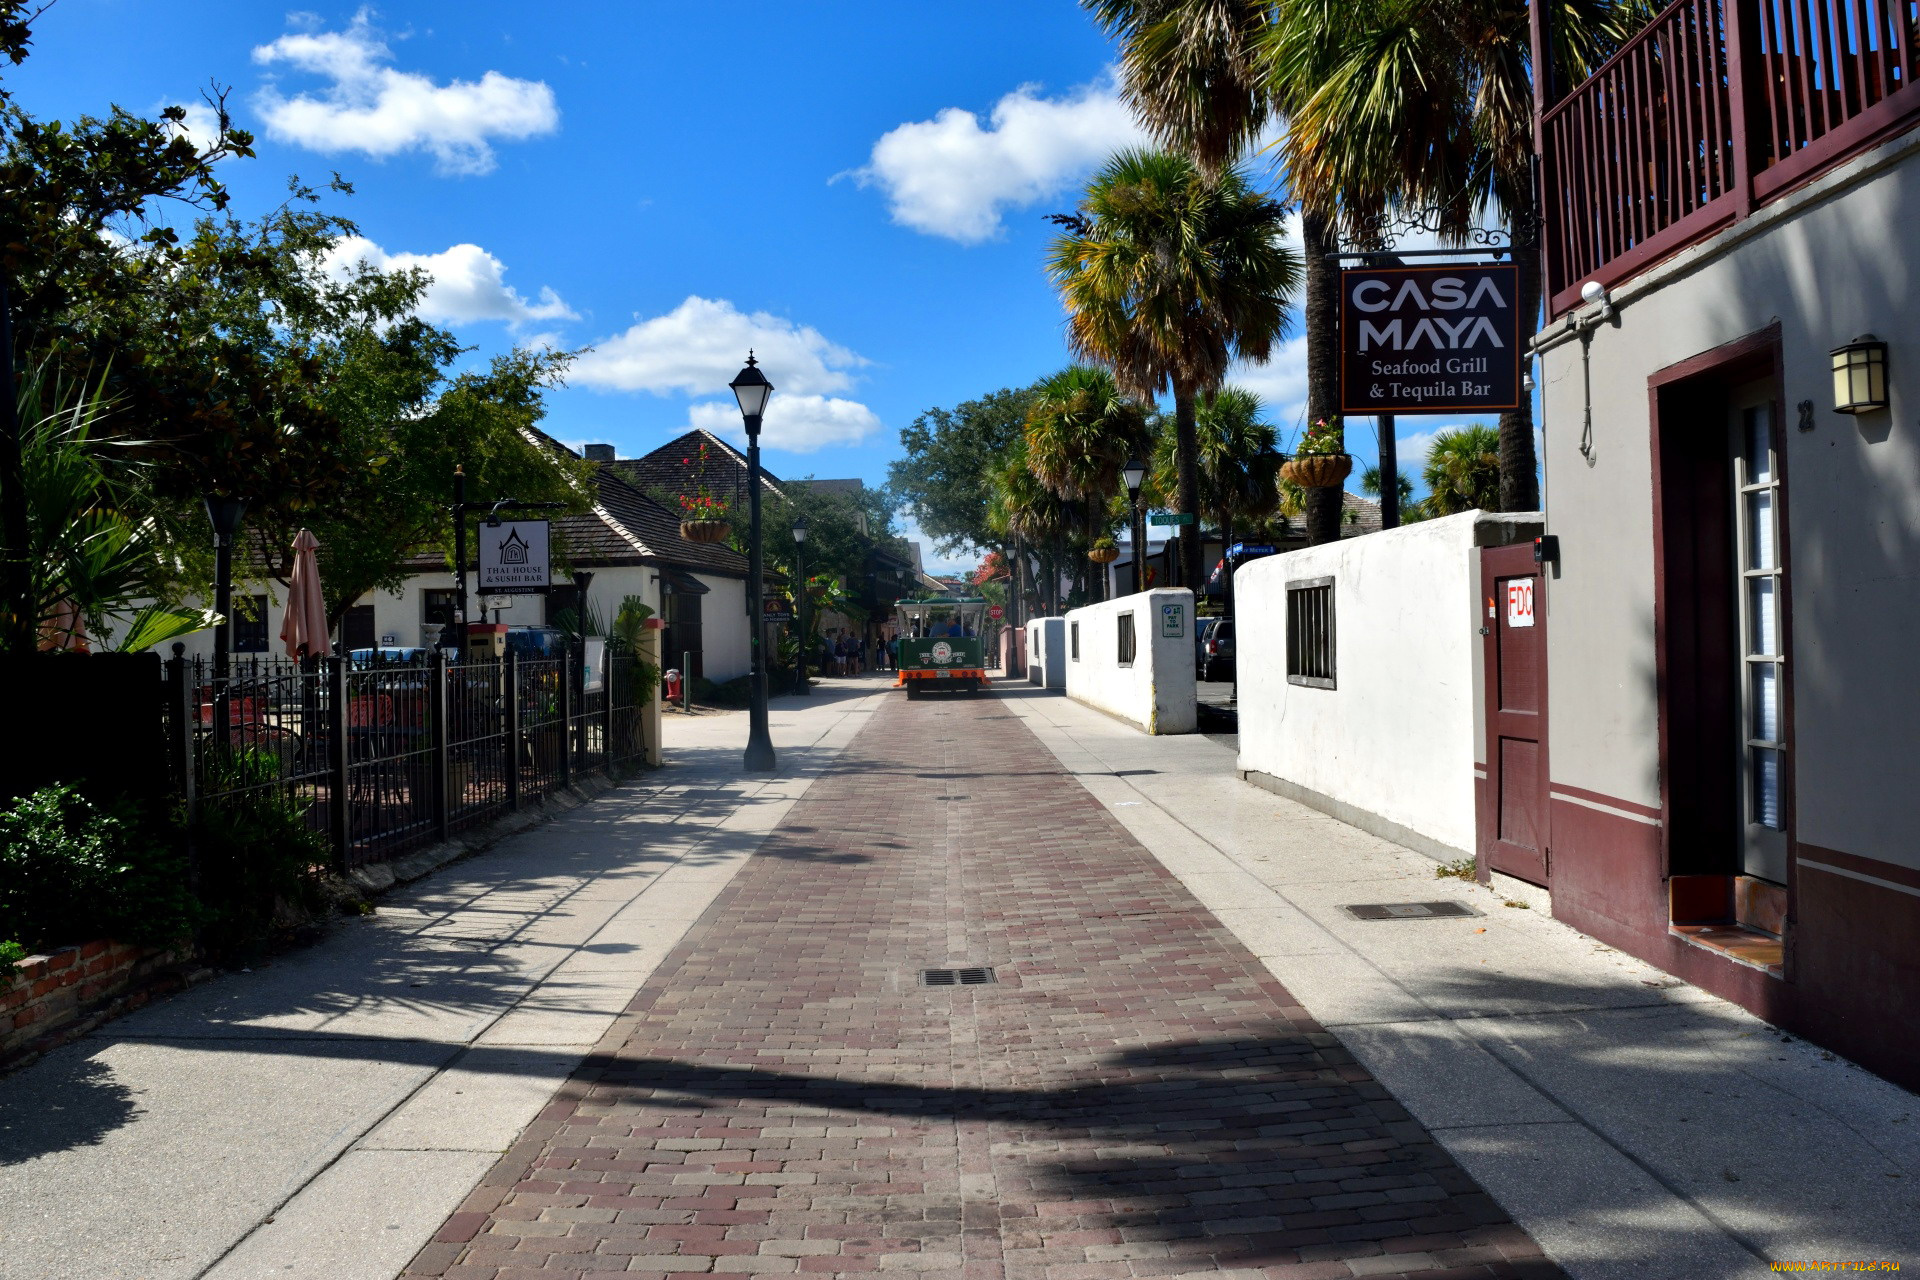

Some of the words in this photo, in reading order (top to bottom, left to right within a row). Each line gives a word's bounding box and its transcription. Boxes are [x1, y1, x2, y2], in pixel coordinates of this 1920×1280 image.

[1352, 276, 1507, 313] CASA
[1359, 316, 1505, 352] MAYA
[1371, 358, 1441, 376] Seafood
[1446, 357, 1488, 374] Grill
[1369, 383, 1385, 398] &
[1389, 381, 1456, 402] Tequila
[1461, 380, 1491, 397] Bar
[486, 567, 509, 575] THAI
[513, 566, 543, 574] HOUSE
[486, 575, 493, 583] &
[495, 575, 521, 583] SUSHI
[524, 574, 543, 582] BAR
[1508, 585, 1533, 616] FDC
